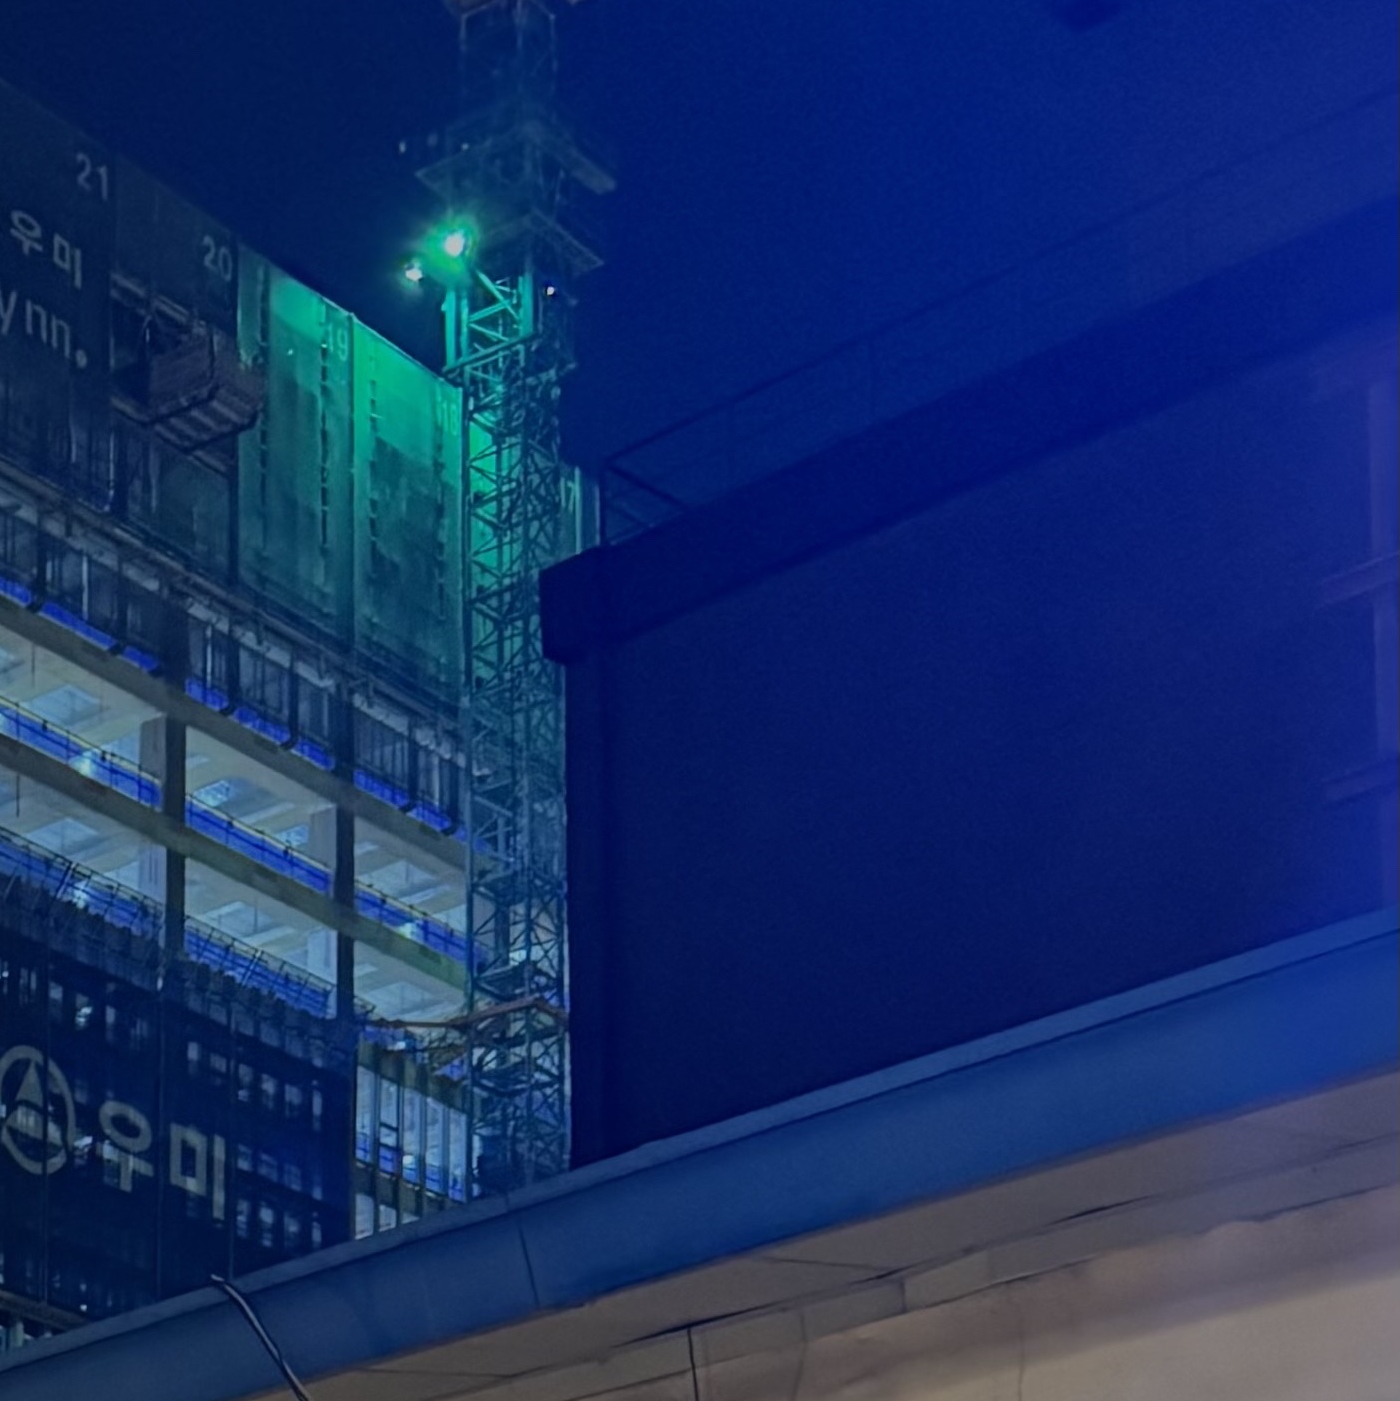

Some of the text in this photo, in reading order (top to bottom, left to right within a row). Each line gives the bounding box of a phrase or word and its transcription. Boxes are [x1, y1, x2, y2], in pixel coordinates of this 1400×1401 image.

[76, 153, 108, 201] 21
[10, 210, 82, 290] 우미
[203, 235, 233, 282] 20
[327, 322, 349, 362] 19
[97, 1100, 226, 1221] 우미
